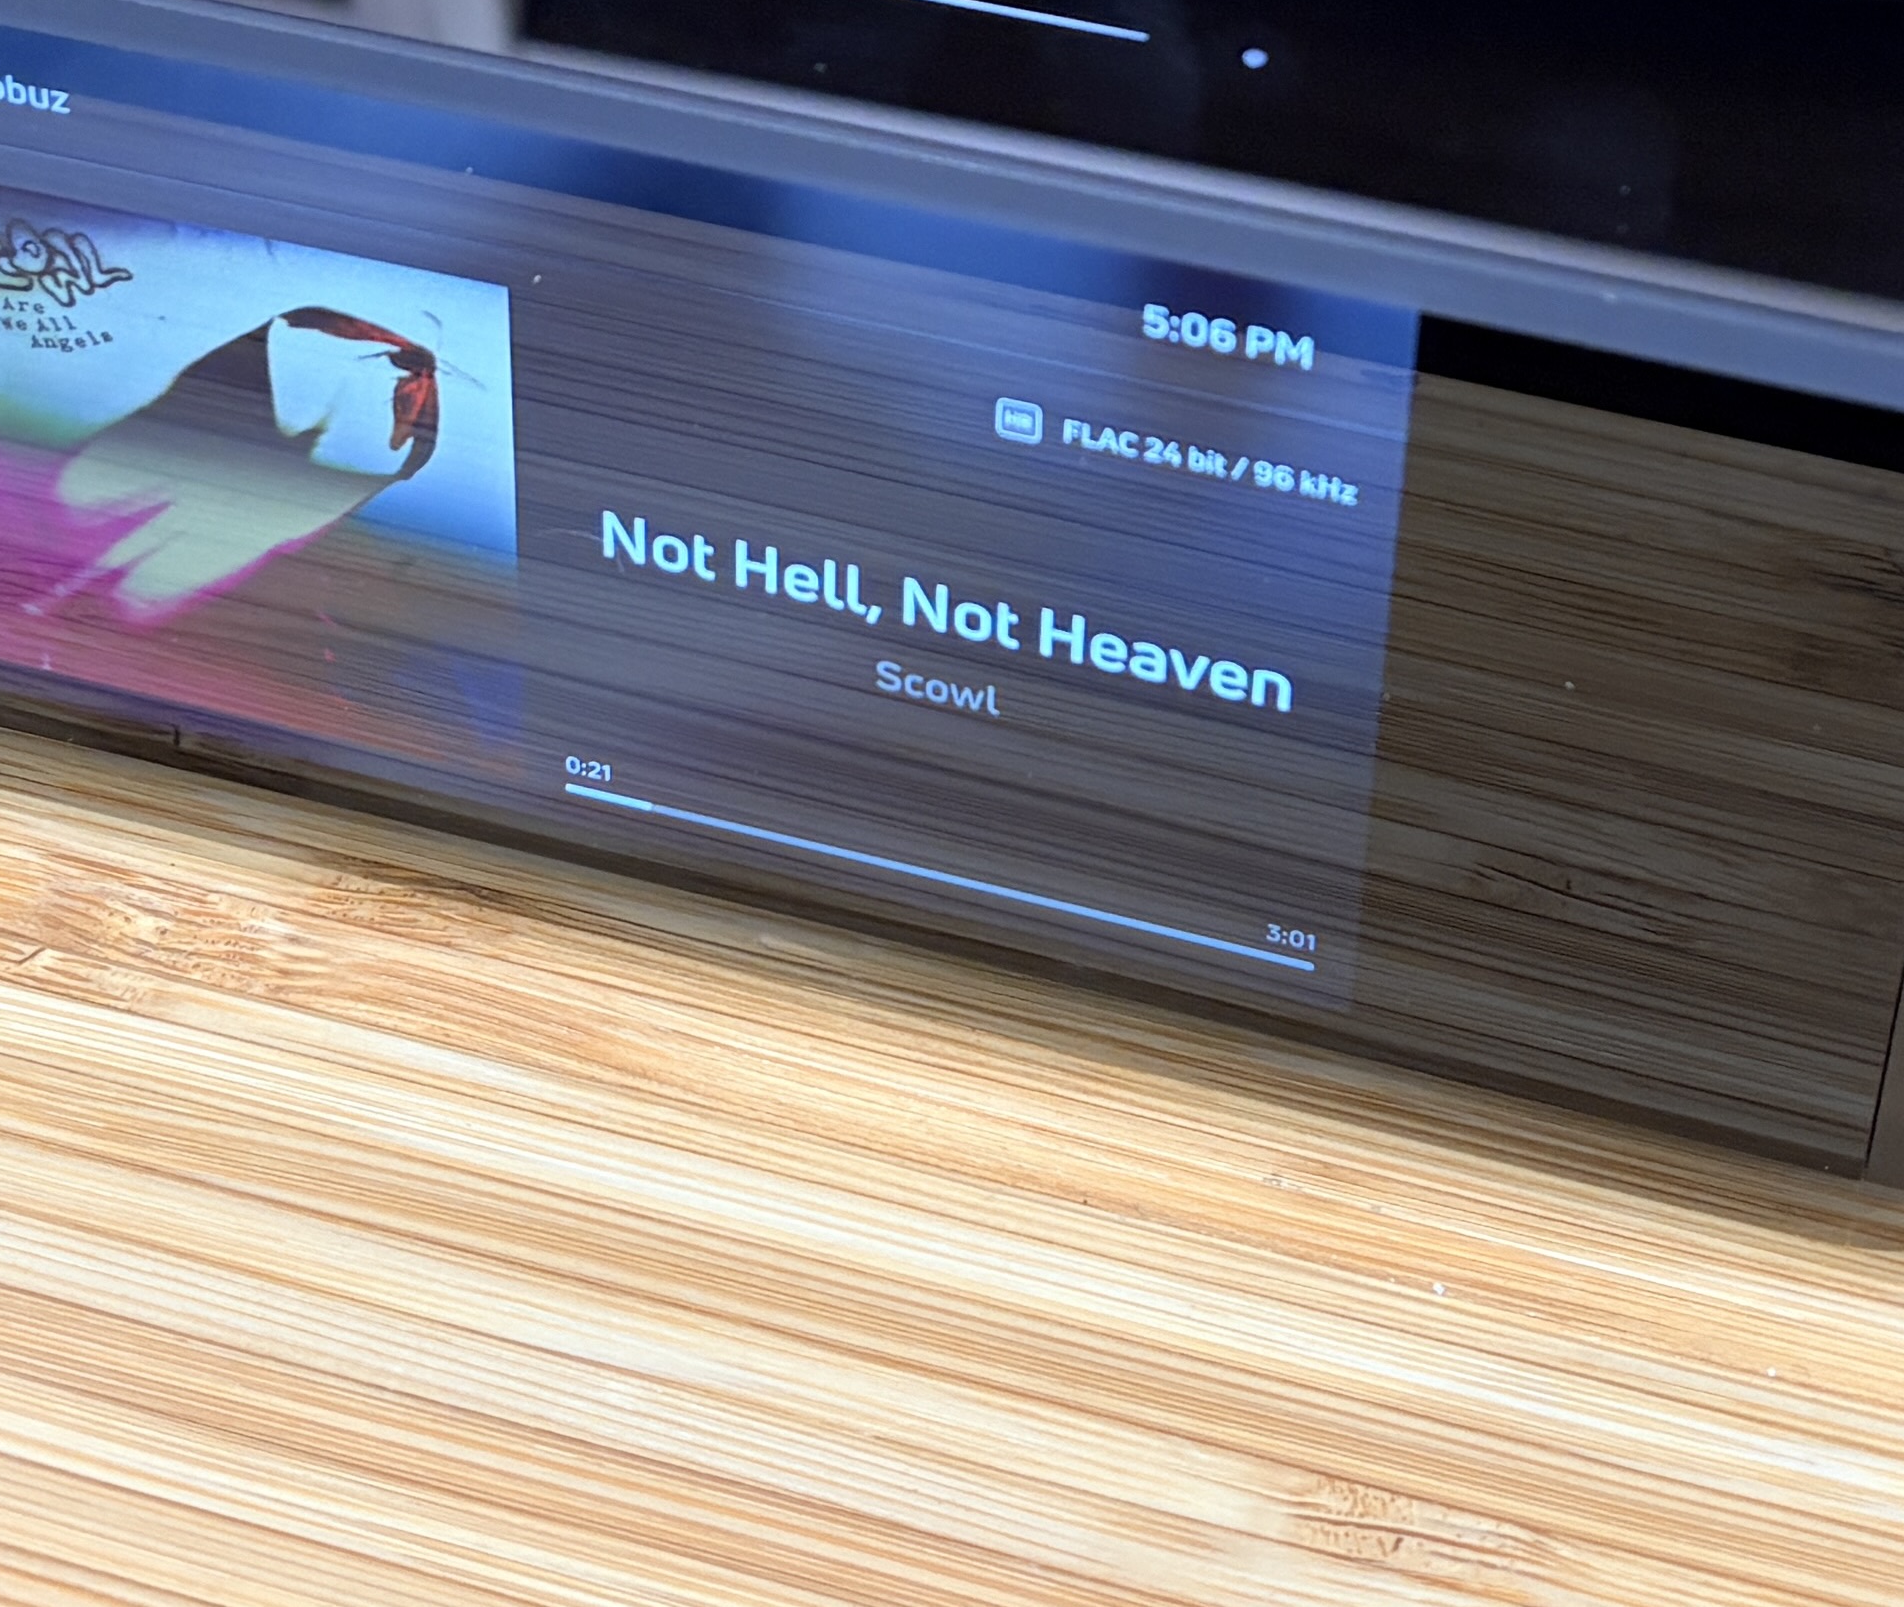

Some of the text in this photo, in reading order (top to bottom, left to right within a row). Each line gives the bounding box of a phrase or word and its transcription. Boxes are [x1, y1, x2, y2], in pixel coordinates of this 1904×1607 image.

[2, 297, 45, 313] Are
[0, 315, 77, 332] We All
[1142, 303, 1315, 371] 5:06 PM
[31, 330, 113, 352] Angels
[1062, 418, 1139, 458] FLAC
[1143, 436, 1183, 467] 24
[1188, 445, 1228, 479] bit
[1253, 460, 1295, 492] 96
[1299, 470, 1359, 507] kHz
[602, 510, 1293, 713] Not Hell, Not Heaven
[875, 660, 1001, 717] Scowl
[565, 755, 612, 782] 0:21
[1265, 923, 1317, 952] 3:01
